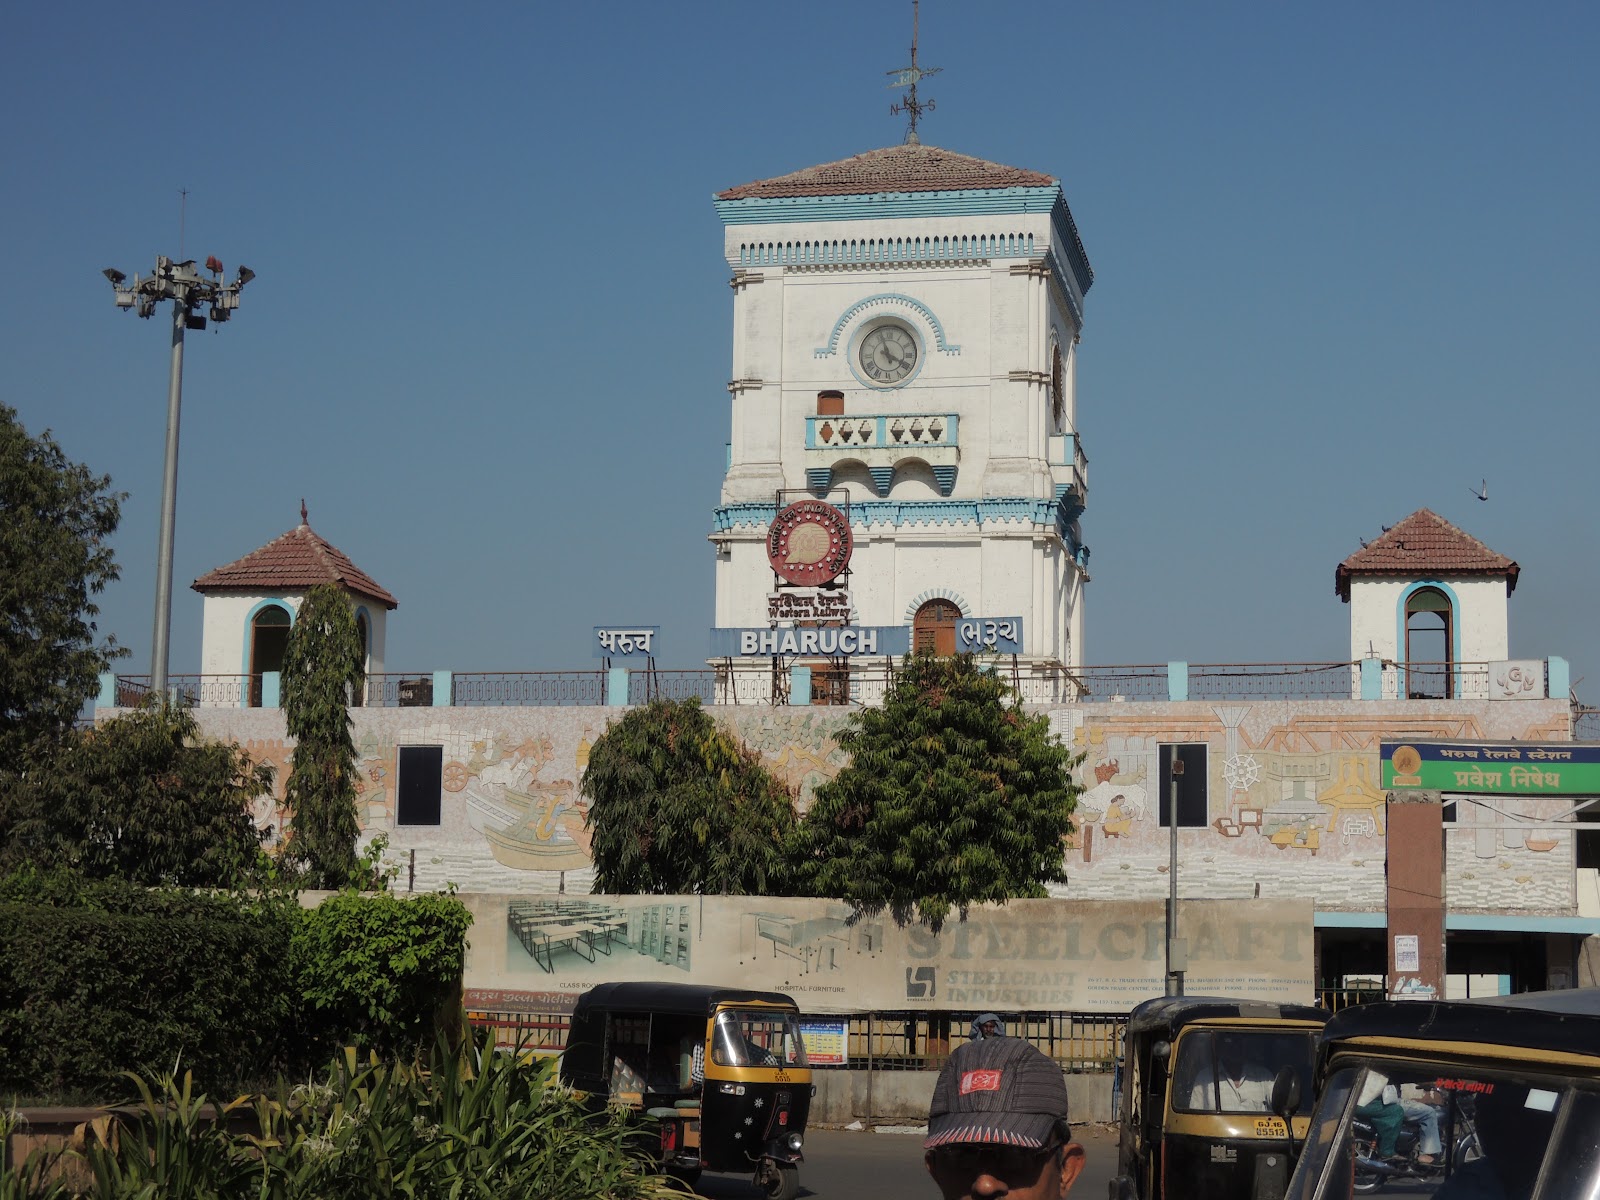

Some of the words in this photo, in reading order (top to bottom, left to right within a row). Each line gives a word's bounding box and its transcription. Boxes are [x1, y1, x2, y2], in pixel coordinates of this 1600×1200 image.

[803, 503, 839, 524] INDIAN
[829, 522, 849, 573] RAILWAYS
[816, 592, 848, 606] रेलवे
[768, 608, 810, 618] Western
[812, 606, 851, 620] Railway
[740, 630, 878, 655] BHARUCH
[1440, 749, 1478, 759] भरुच
[1483, 748, 1521, 760] रेलवे
[1526, 748, 1572, 760] स्टेशन
[1454, 765, 1502, 788] प्रवेश
[1509, 766, 1560, 788] निषेध
[947, 970, 1077, 986] STEELCRAFT
[947, 988, 1074, 1004] INDUSTRIES
